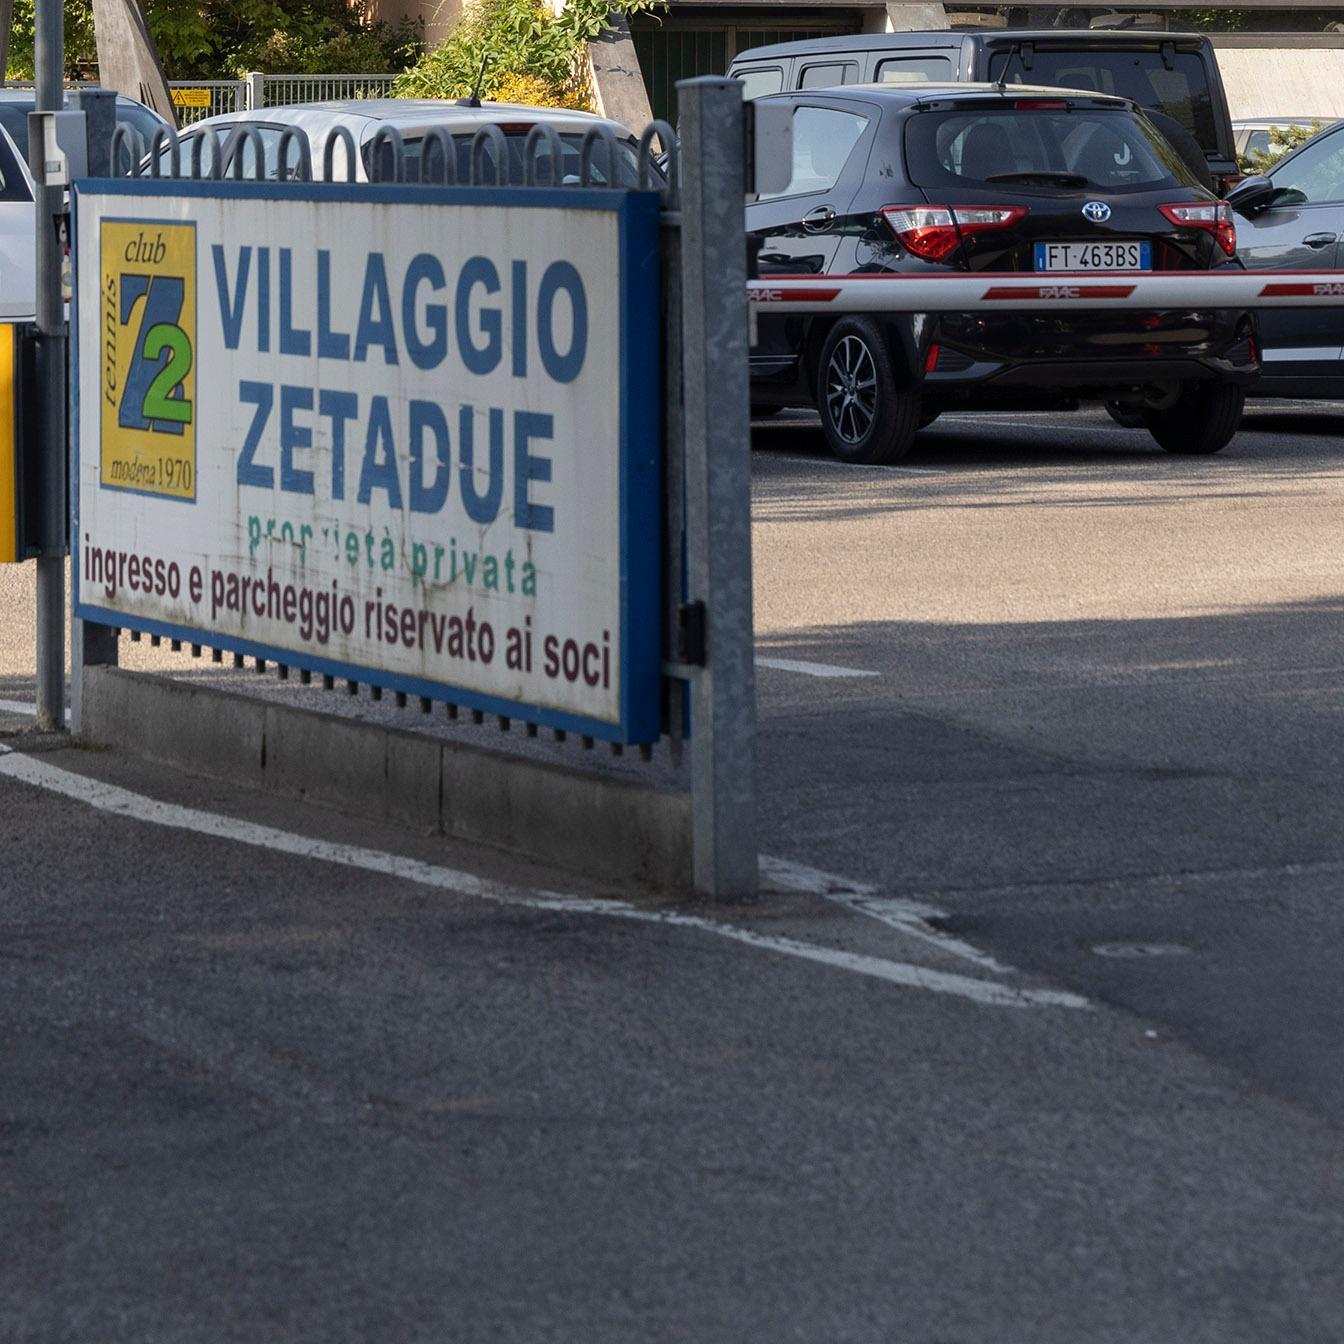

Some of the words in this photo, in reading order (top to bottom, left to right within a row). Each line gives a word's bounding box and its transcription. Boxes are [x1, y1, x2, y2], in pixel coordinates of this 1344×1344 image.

[124, 232, 167, 265] club
[210, 243, 588, 384] VILLAGGIO
[1039, 286, 1080, 299] FAAC
[102, 274, 117, 408] tennis
[236, 379, 555, 534] ZETADUE
[84, 533, 181, 599] ingresso
[189, 565, 203, 604] e
[211, 567, 356, 645] parcheggio
[365, 587, 495, 664] riservato
[505, 615, 532, 673] ai
[543, 629, 611, 689] soci
[411, 537, 537, 597] privata
